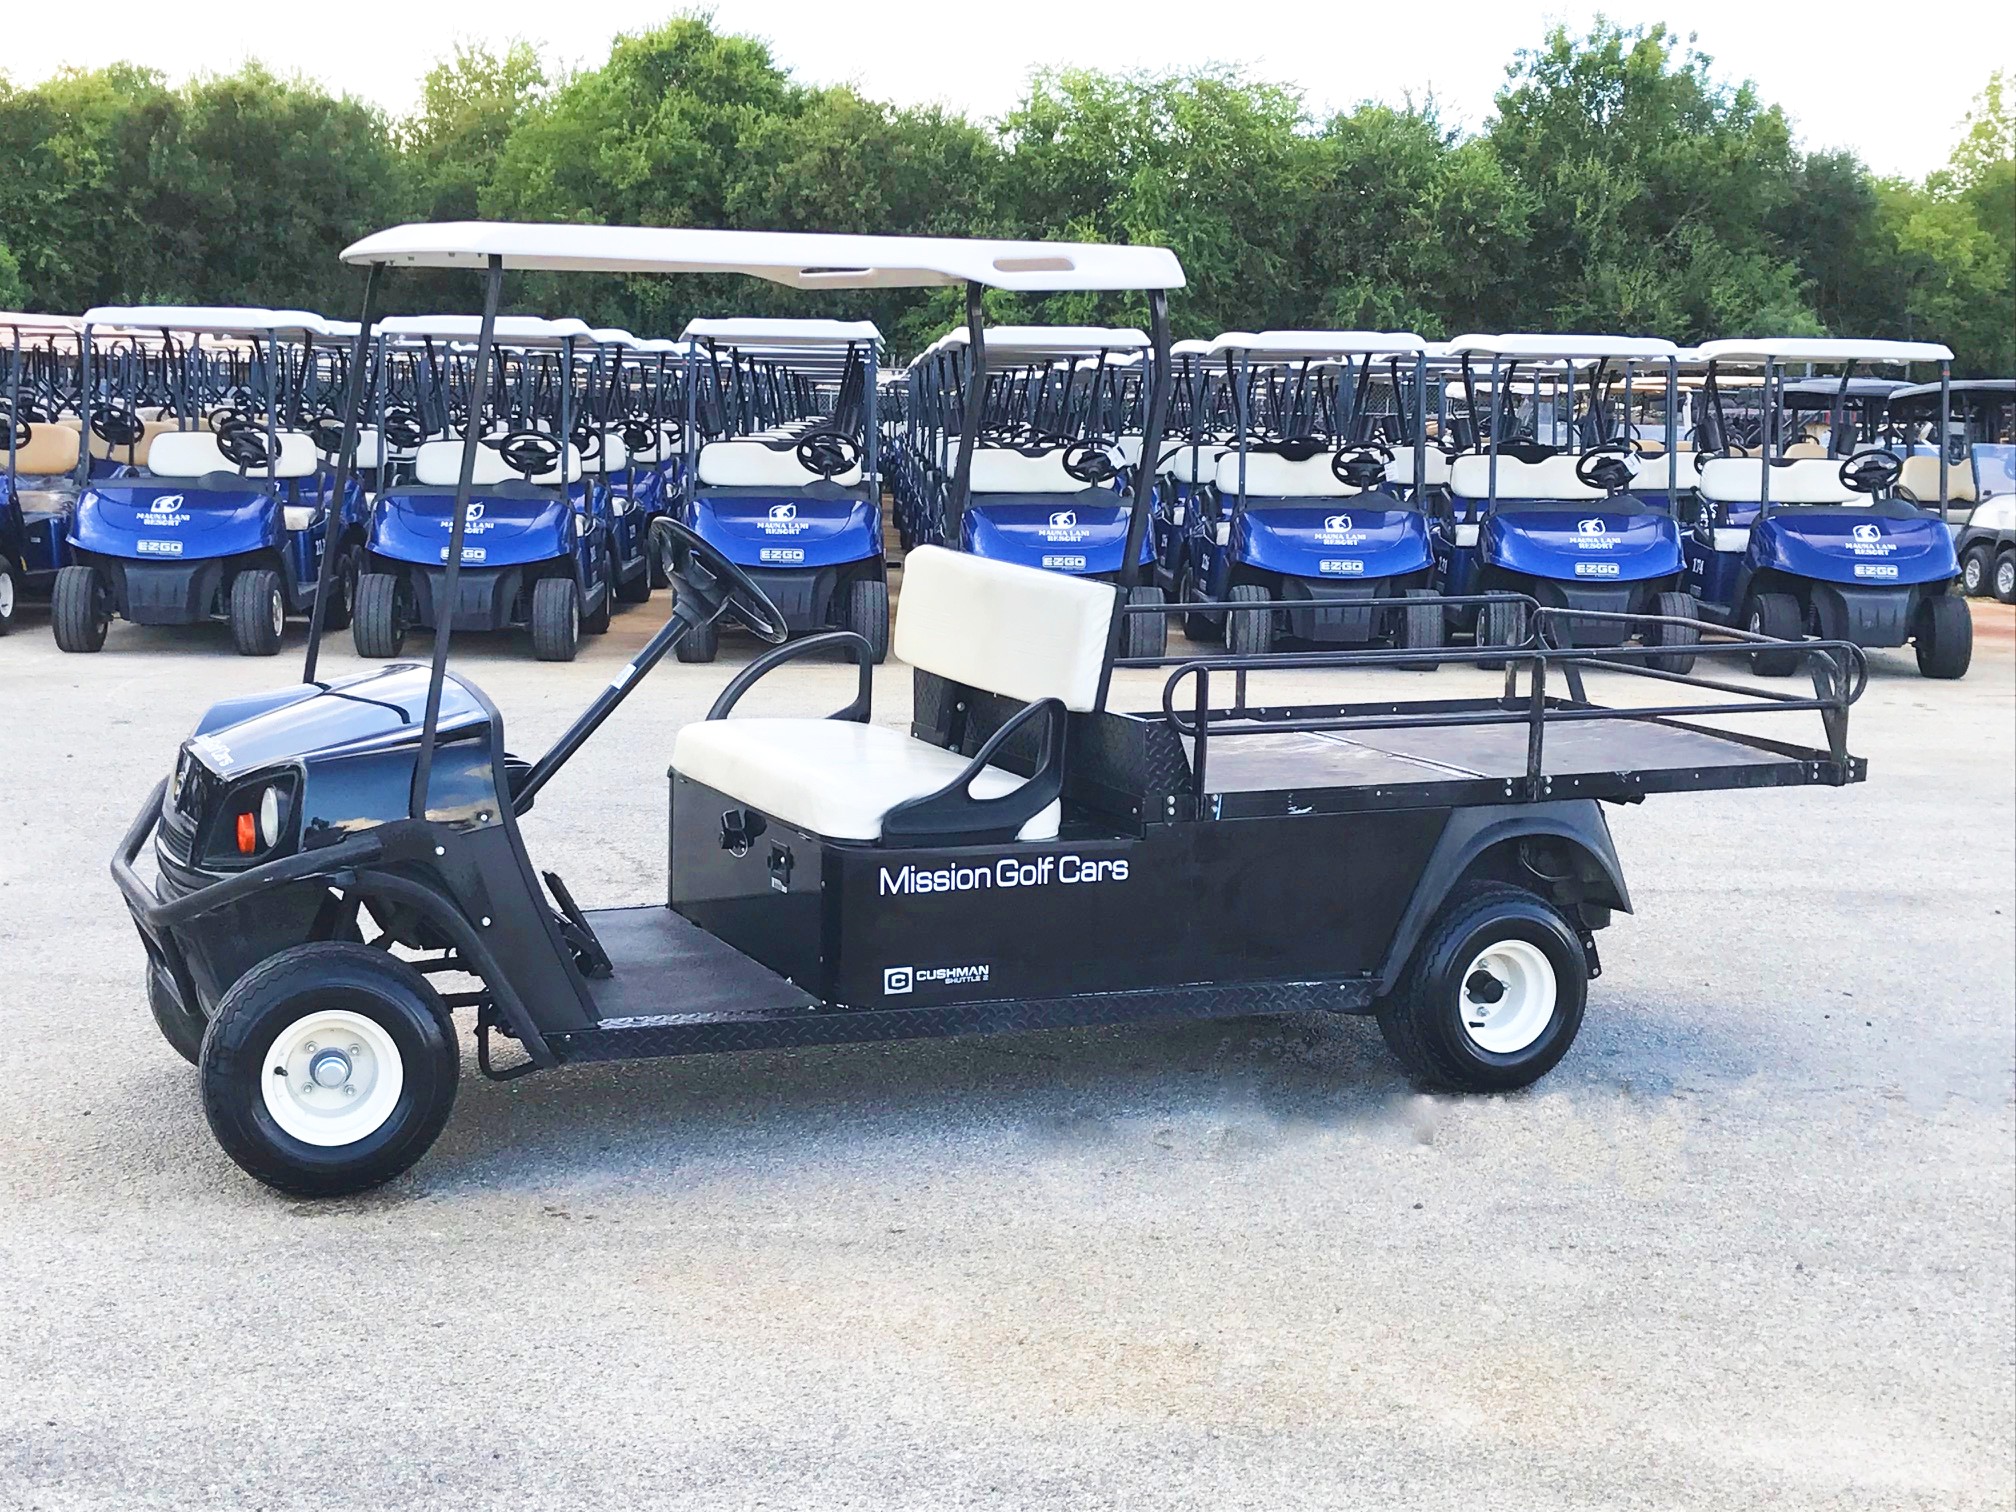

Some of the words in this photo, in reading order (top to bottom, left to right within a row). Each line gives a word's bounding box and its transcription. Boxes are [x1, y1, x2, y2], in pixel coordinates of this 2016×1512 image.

[879, 862, 992, 896] Mission
[996, 856, 1055, 888] Golf
[1058, 855, 1130, 884] Cars
[916, 964, 989, 981] CUSHMAN
[944, 975, 981, 985] SHUTTLE
